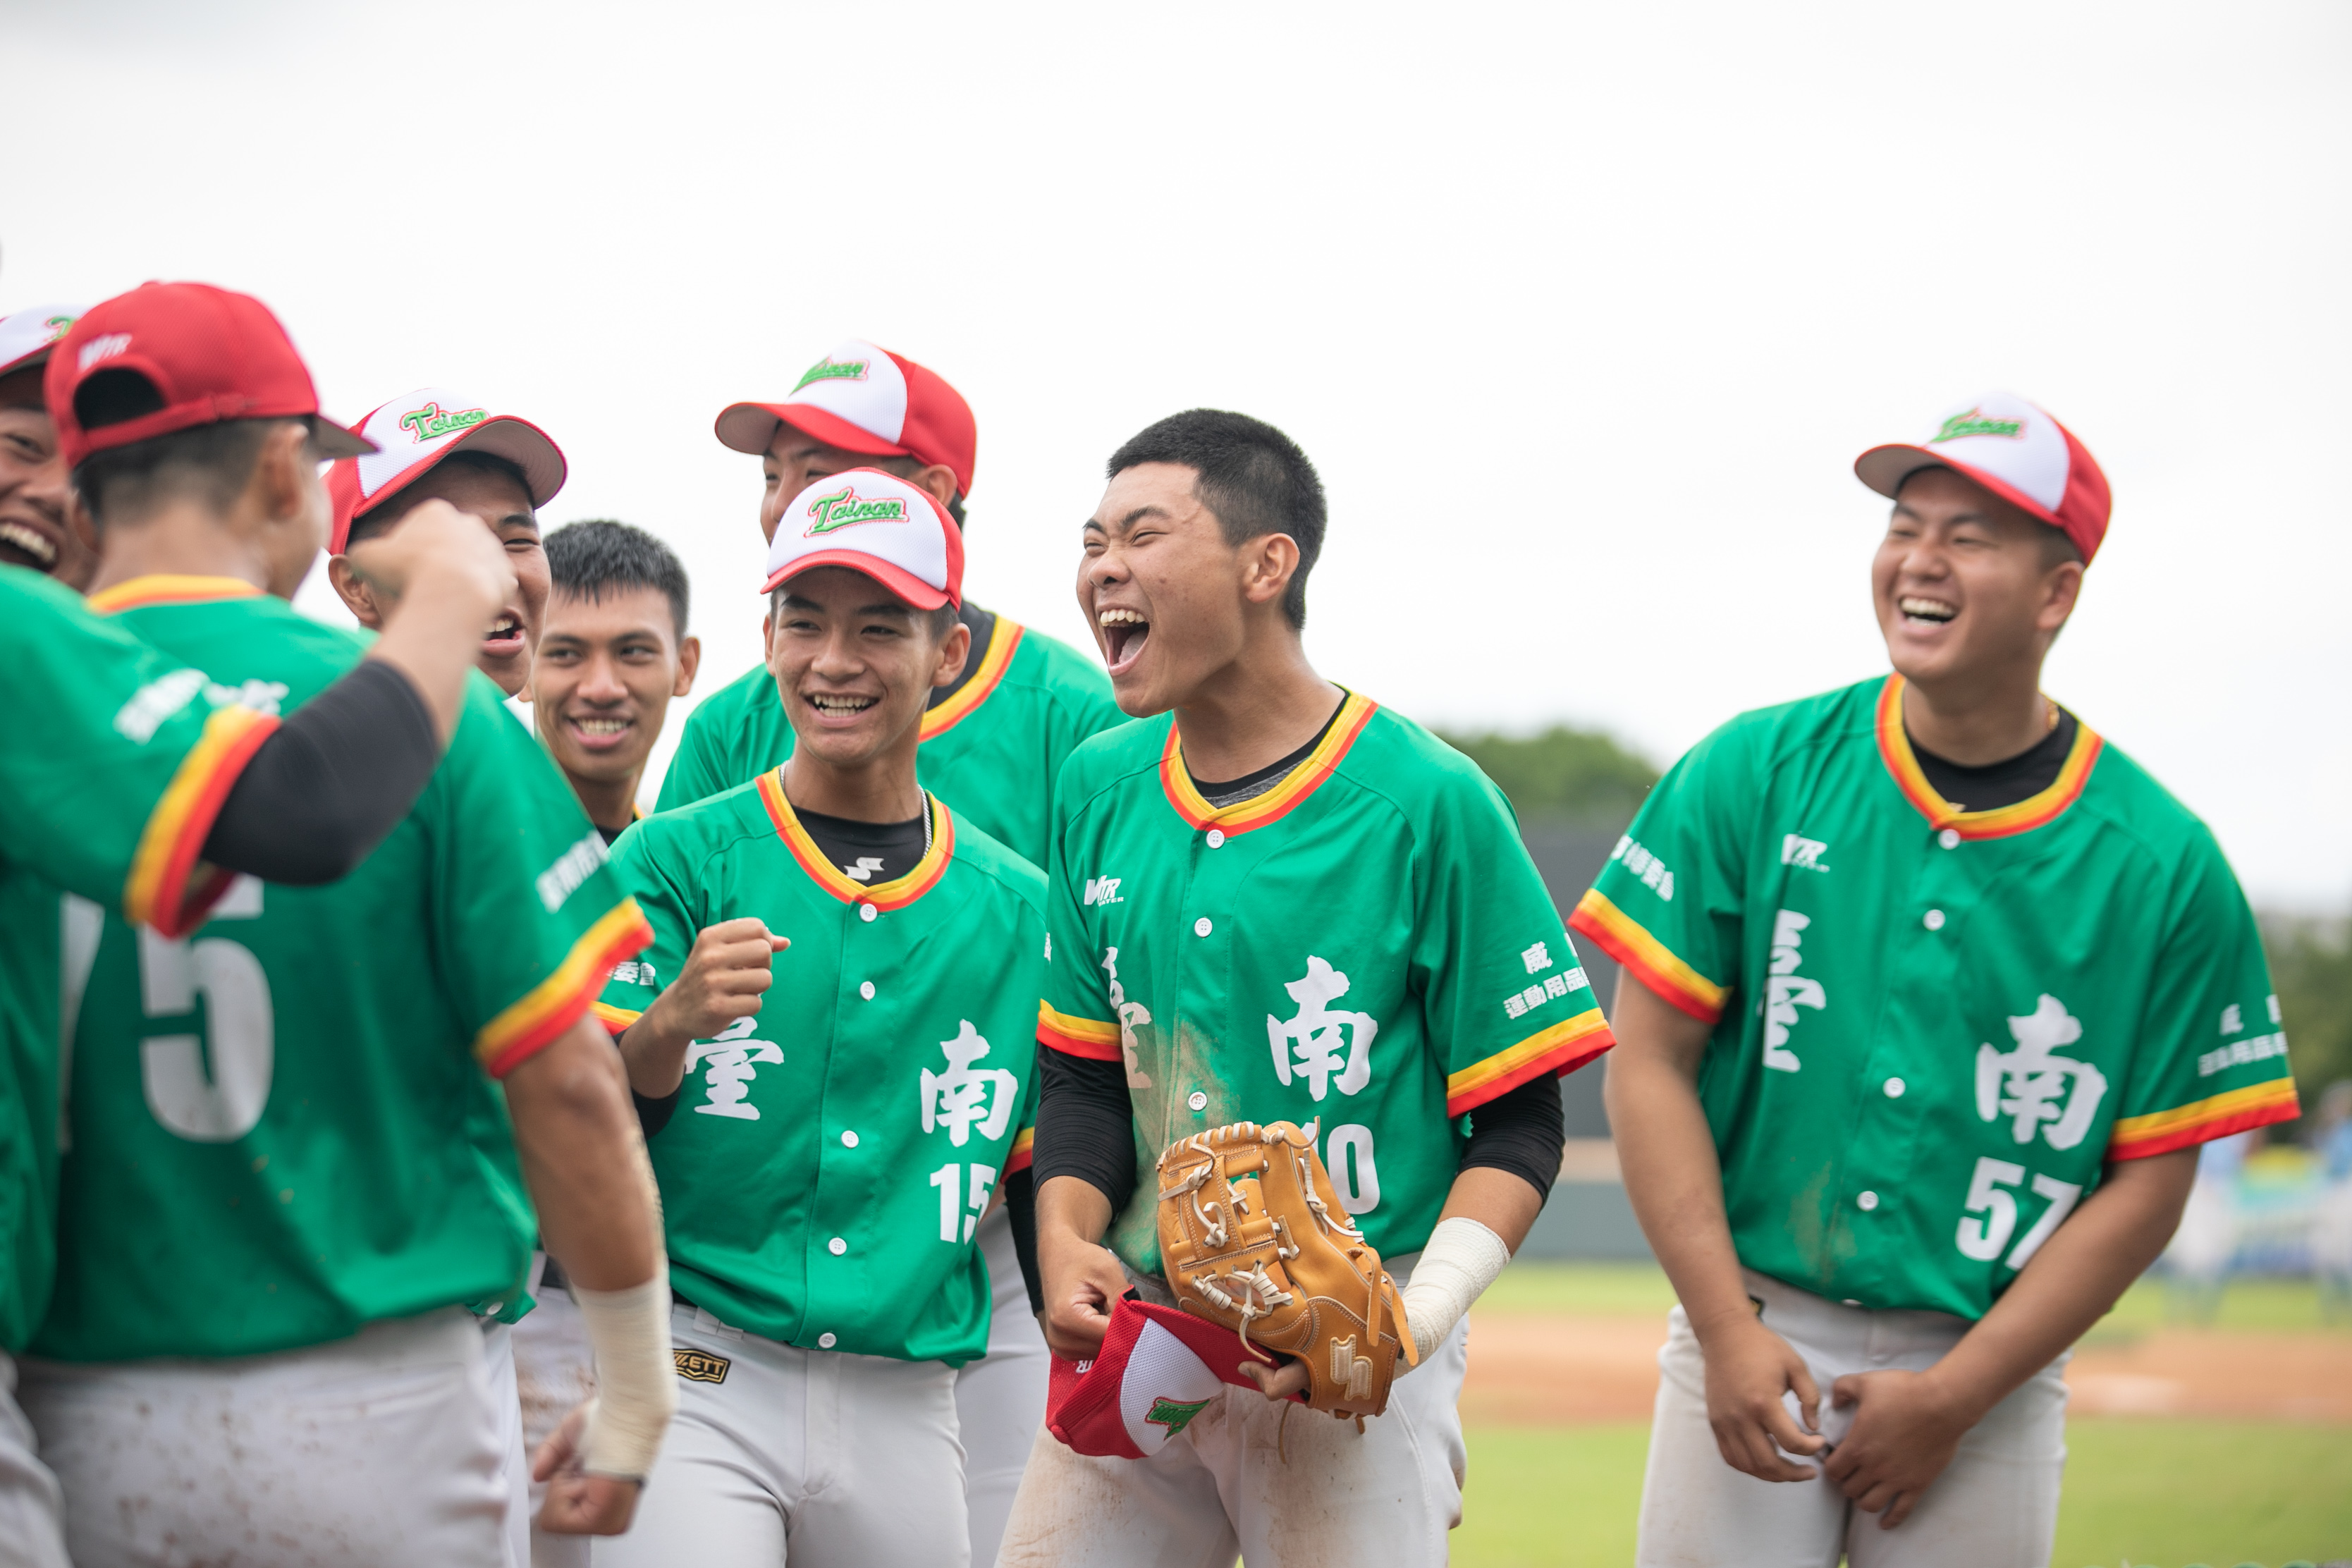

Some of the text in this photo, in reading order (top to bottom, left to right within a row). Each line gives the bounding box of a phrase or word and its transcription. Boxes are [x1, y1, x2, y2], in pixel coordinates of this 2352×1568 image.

[400, 402, 491, 443] Tainan
[804, 486, 909, 538] Tainan
[606, 961, 656, 986] 委會
[1267, 955, 1378, 1102] 南
[1976, 993, 2108, 1151] 南
[920, 1019, 1019, 1147] 南
[930, 1163, 997, 1246] 15
[1955, 1156, 2082, 1271] 57
